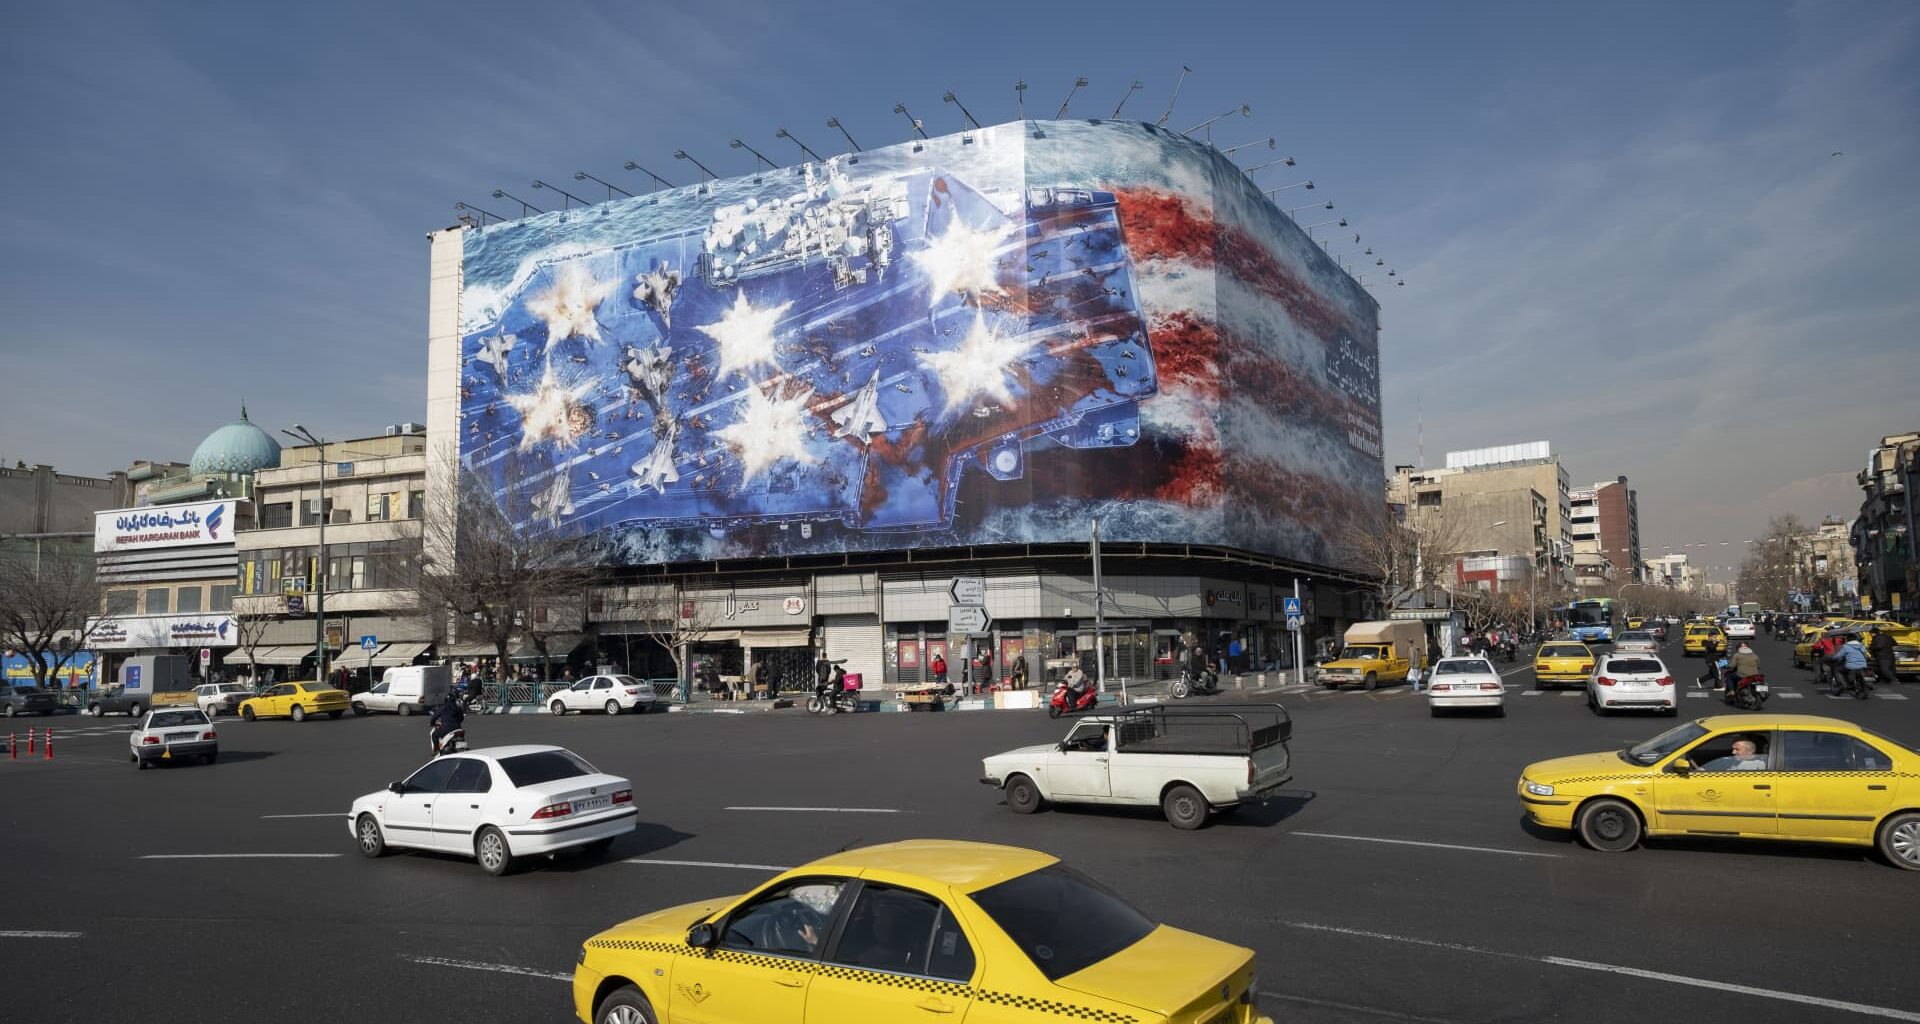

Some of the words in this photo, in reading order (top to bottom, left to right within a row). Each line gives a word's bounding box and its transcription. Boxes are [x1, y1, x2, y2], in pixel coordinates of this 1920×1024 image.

[116, 513, 149, 532] کارگران
[149, 510, 174, 528] رفاه
[174, 510, 200, 528] بانک
[116, 535, 138, 544] REFAH
[139, 532, 179, 543] KARGARAN
[180, 530, 200, 539] BANK
[738, 601, 759, 613] کفش
